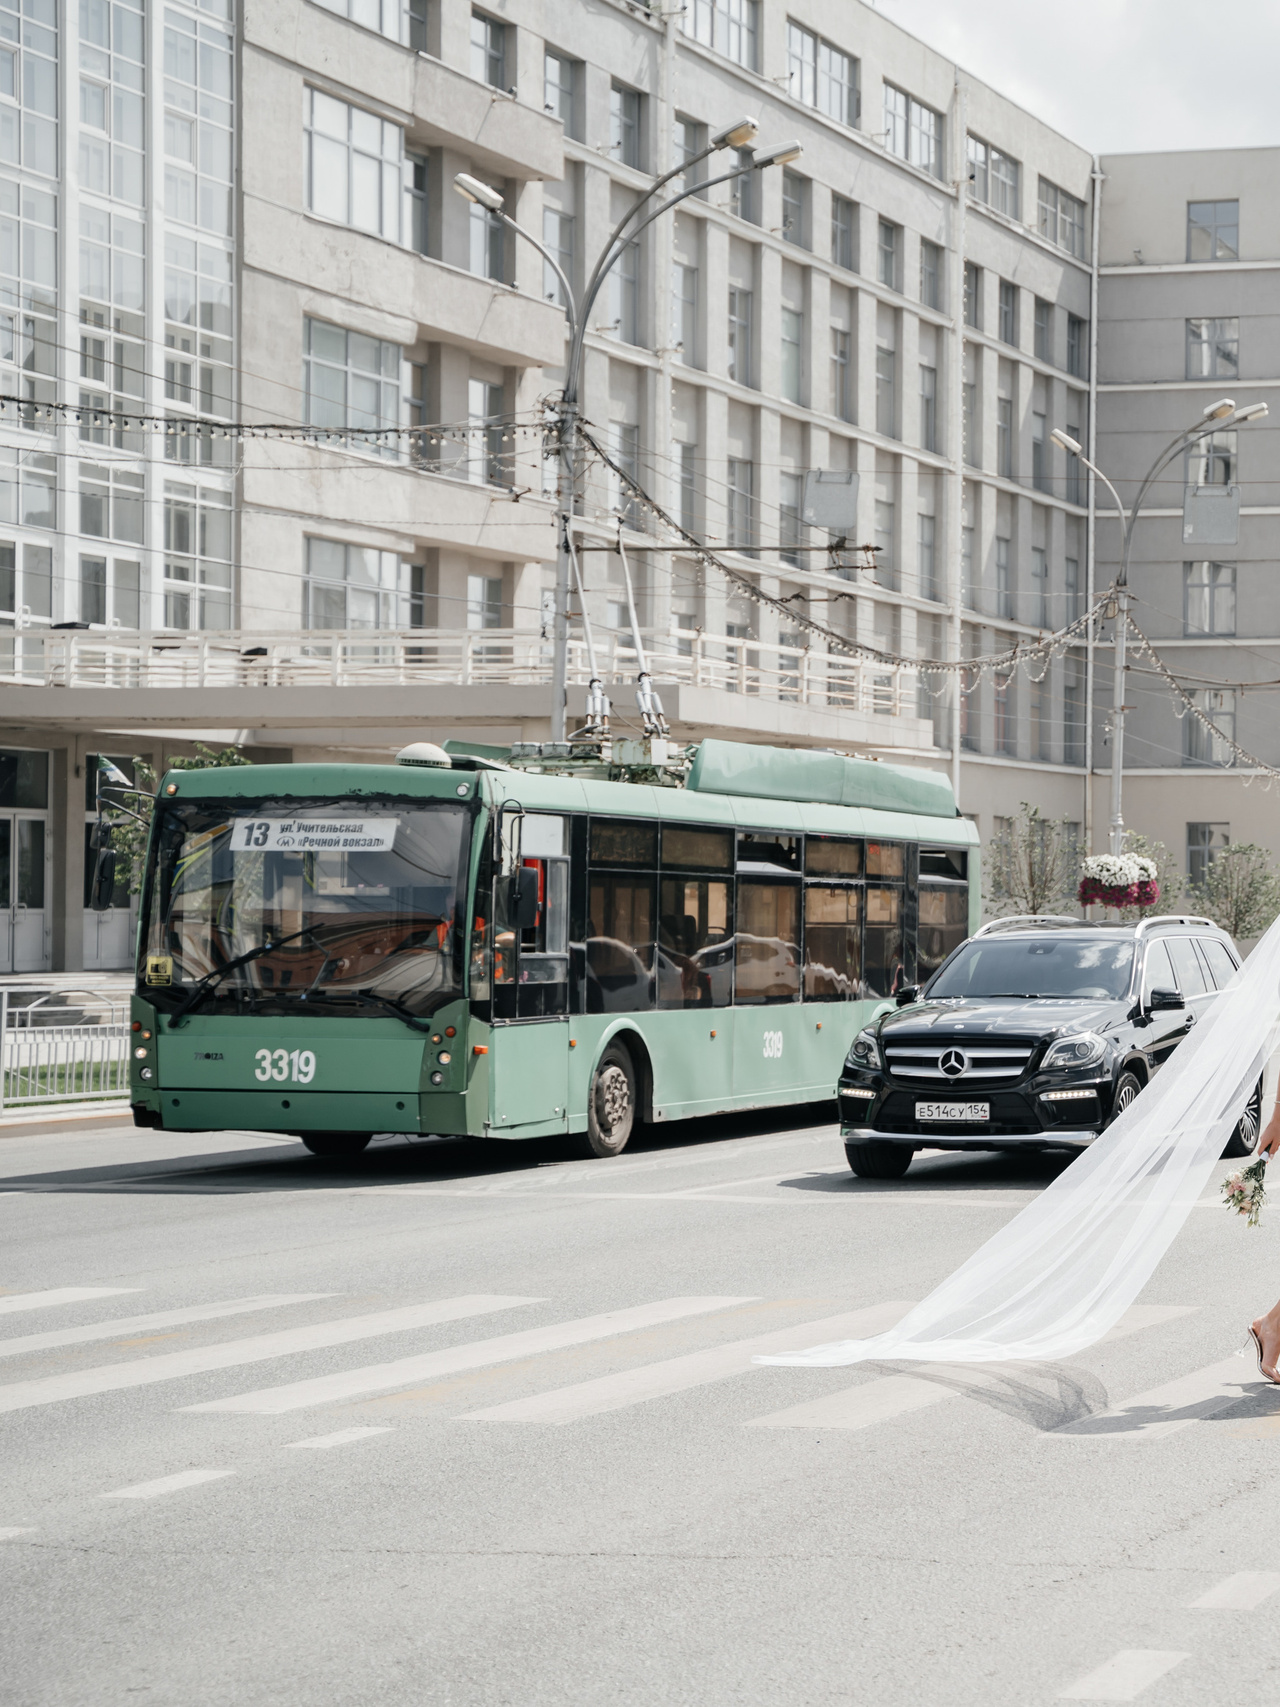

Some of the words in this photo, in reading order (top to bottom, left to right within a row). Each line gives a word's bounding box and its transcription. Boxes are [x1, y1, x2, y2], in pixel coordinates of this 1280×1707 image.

[243, 822, 271, 847] 13
[296, 822, 364, 834] Учительская
[763, 1030, 783, 1059] 3319
[254, 1048, 316, 1084] 3319
[967, 1104, 988, 1115] 154
